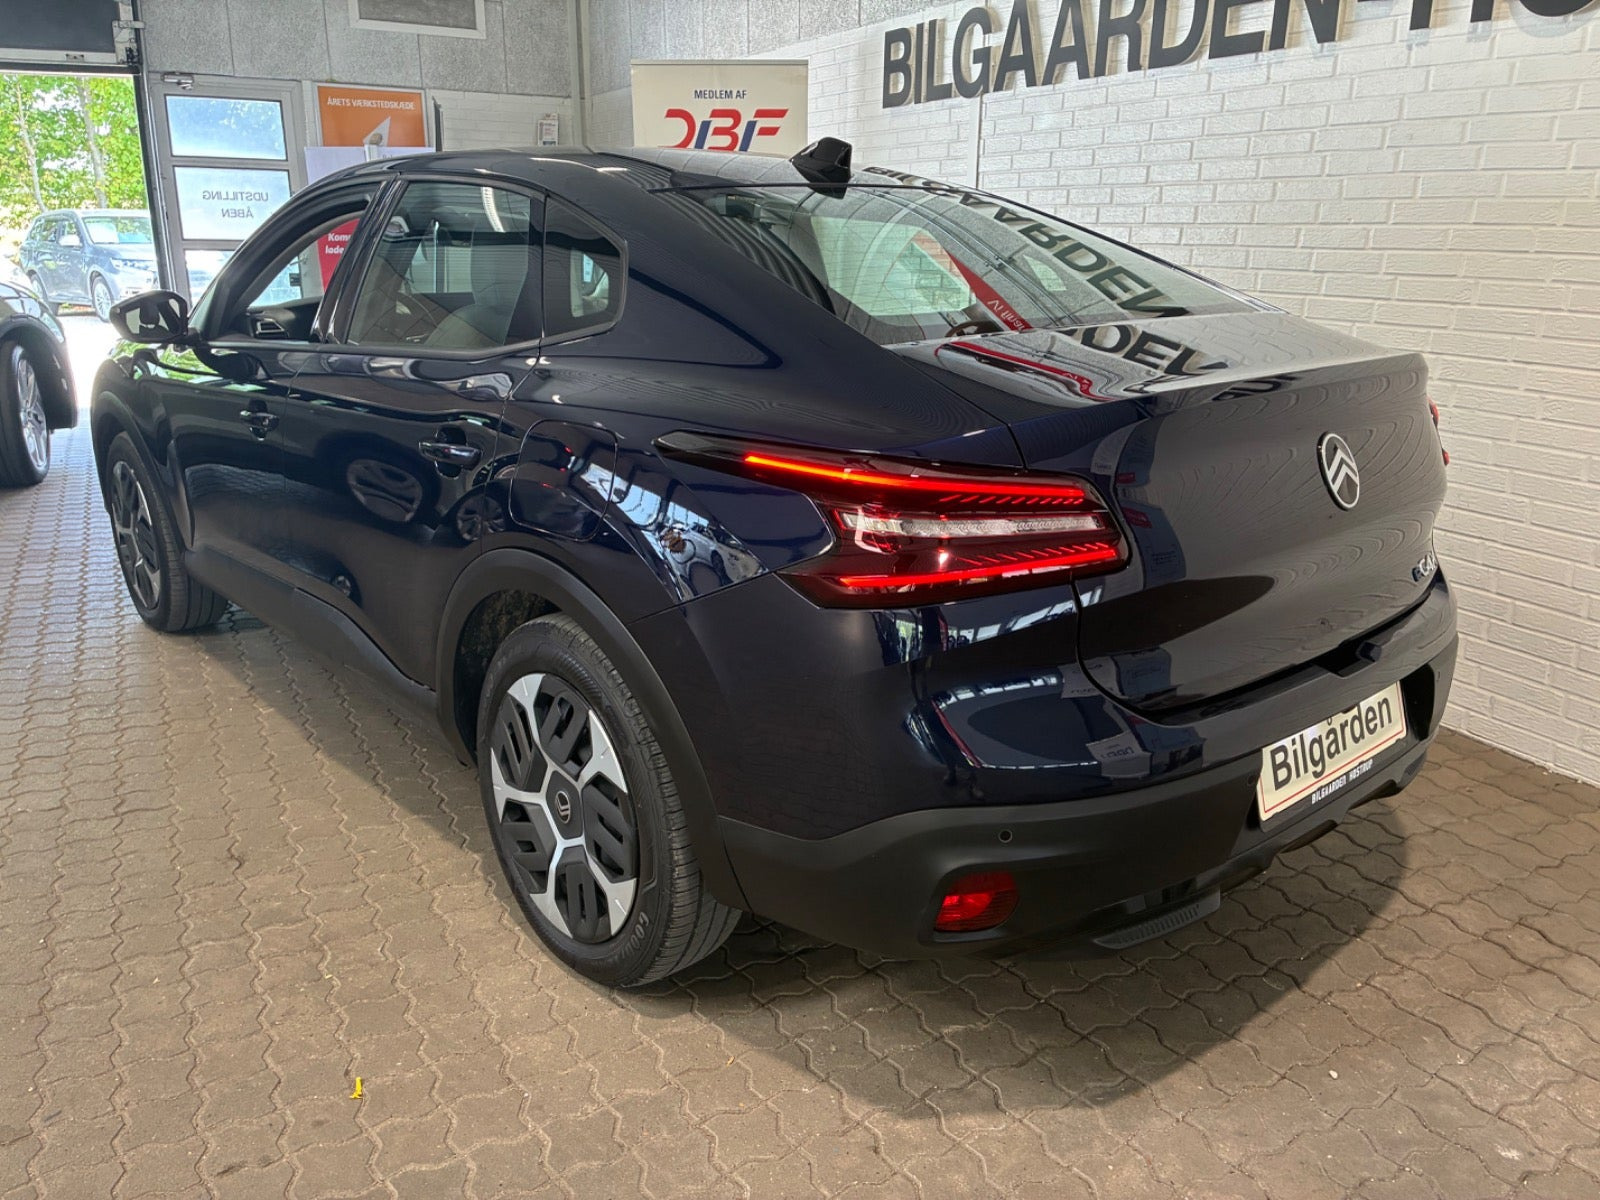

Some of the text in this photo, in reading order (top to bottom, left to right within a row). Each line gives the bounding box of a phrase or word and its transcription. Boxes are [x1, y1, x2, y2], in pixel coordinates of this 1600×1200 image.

[694, 89, 748, 100] MEDLEM AF
[327, 96, 351, 107] ÅRETS
[1269, 697, 1393, 791] Bilgården
